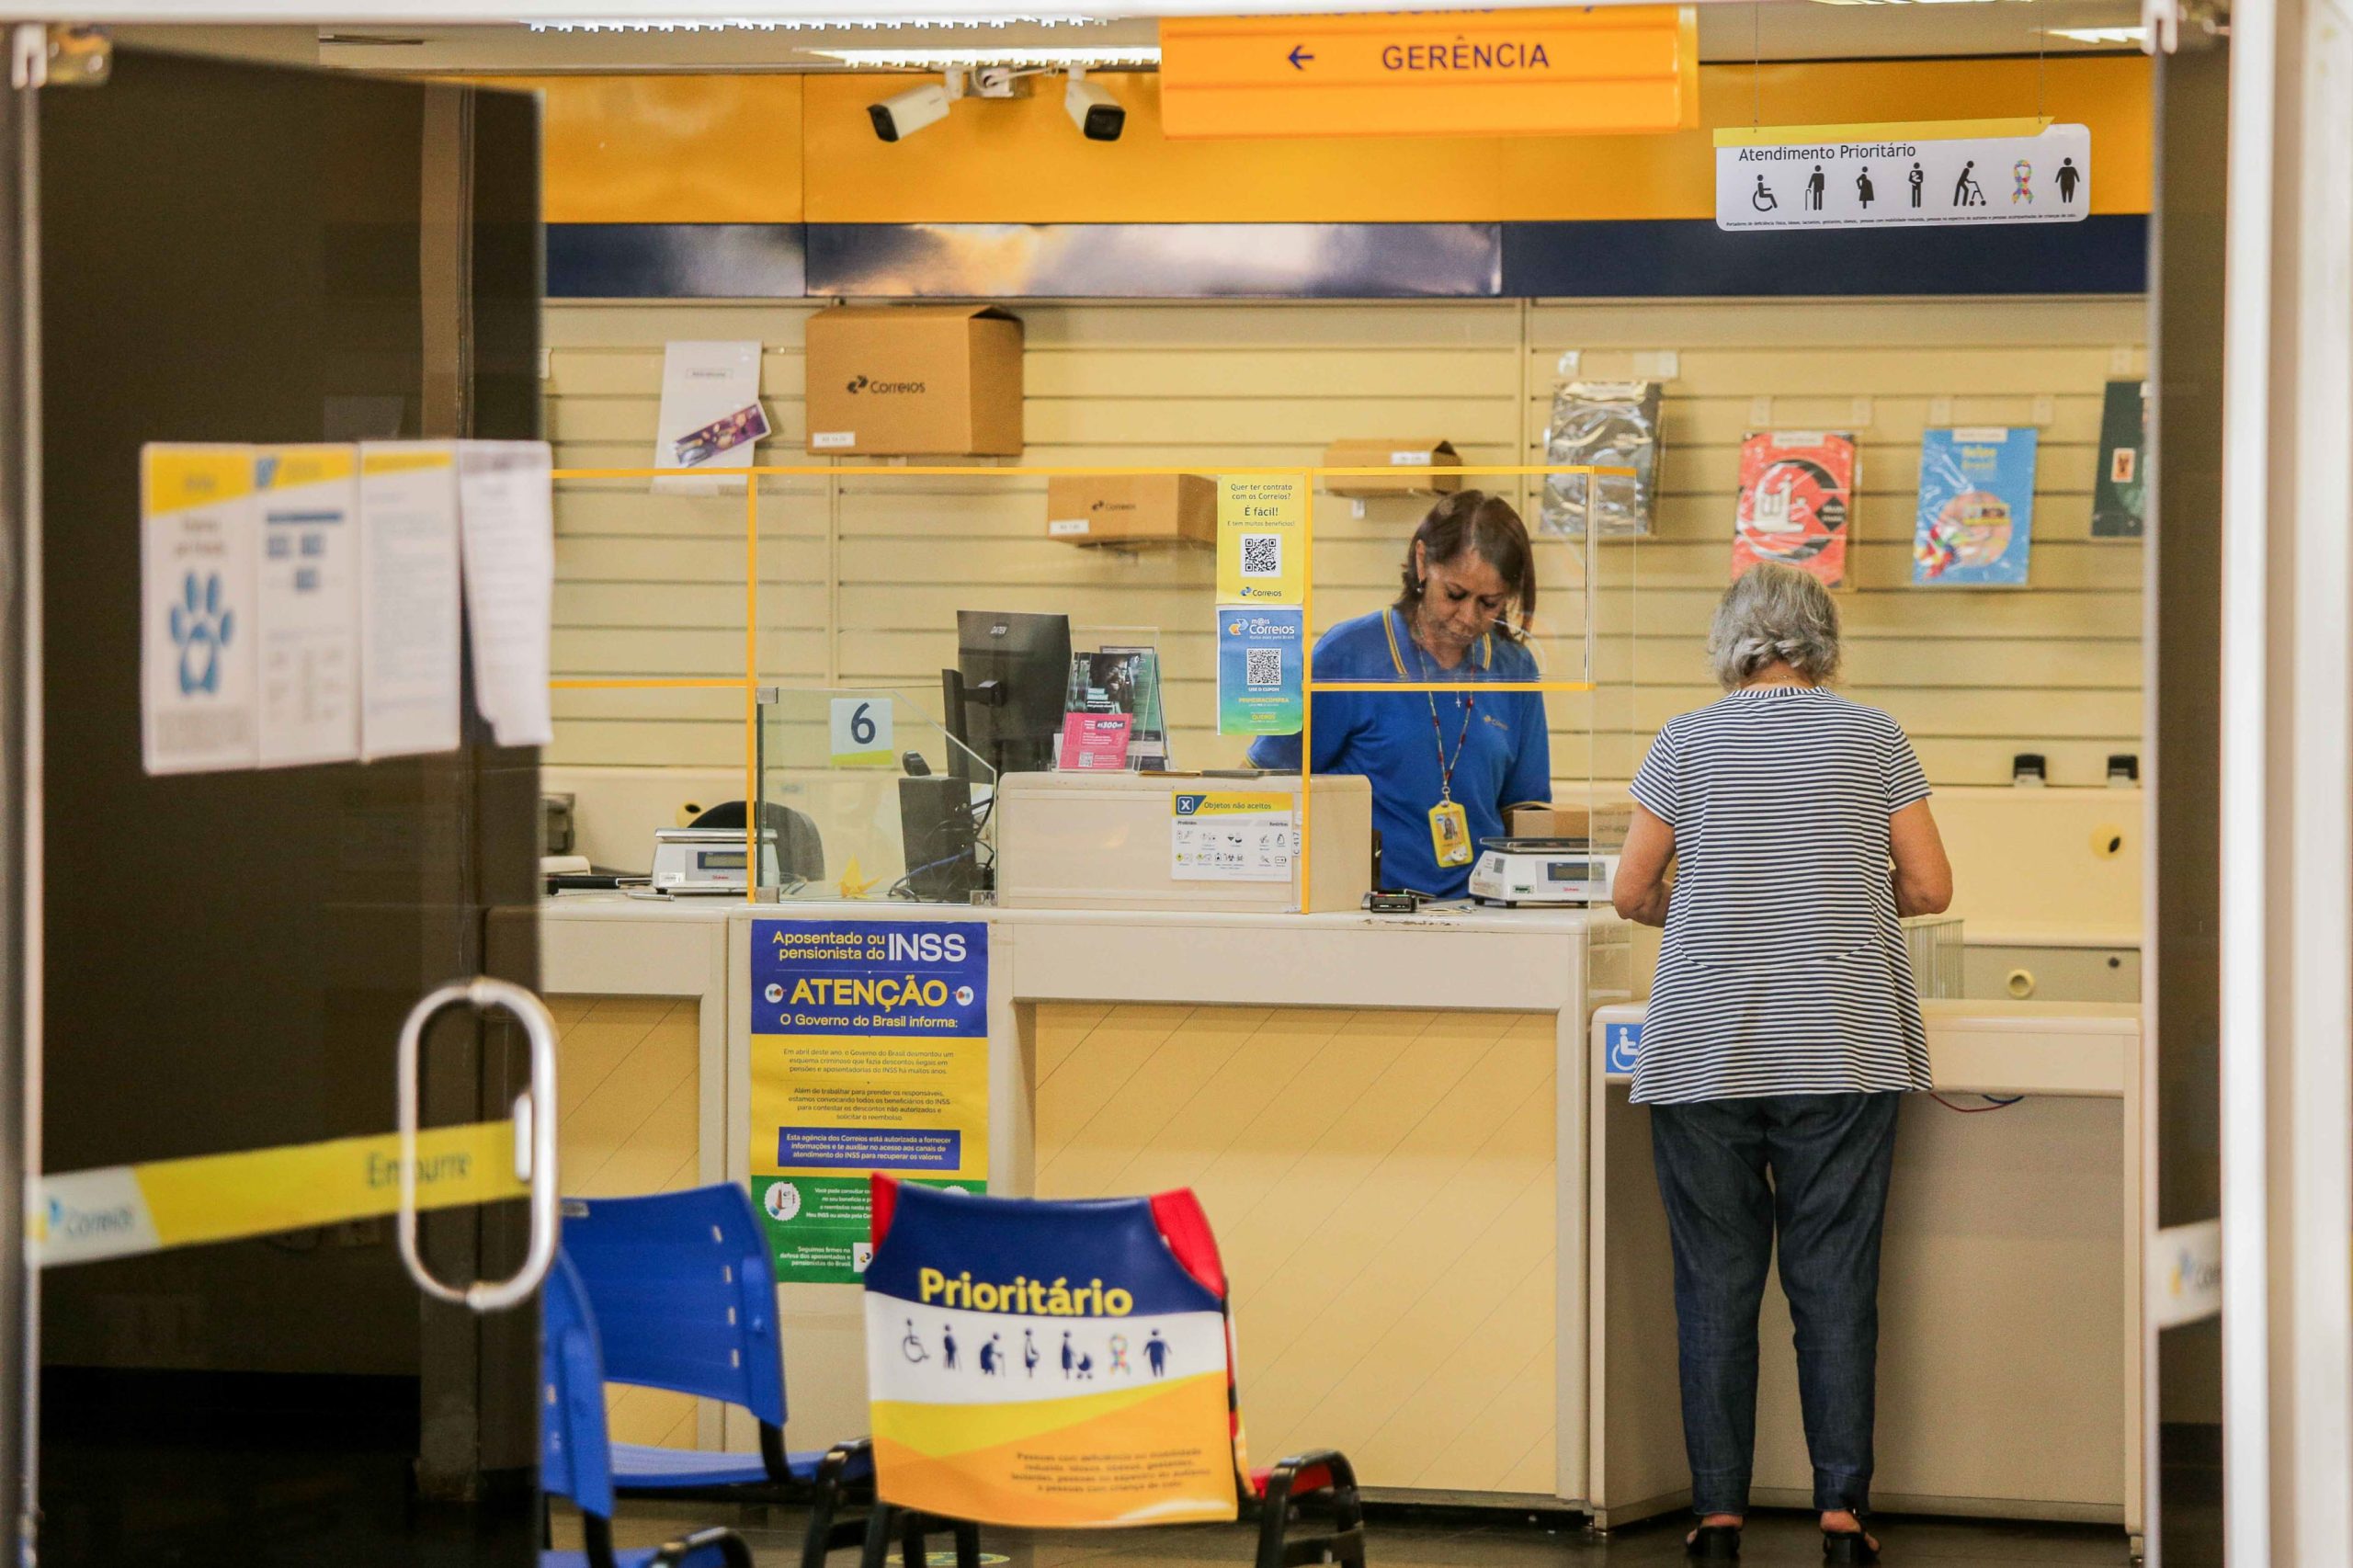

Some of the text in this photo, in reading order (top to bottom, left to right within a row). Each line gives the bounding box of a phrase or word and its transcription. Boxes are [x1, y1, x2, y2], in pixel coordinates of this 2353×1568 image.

[1382, 36, 1550, 71] GERÊNCIA
[1739, 143, 1916, 162] Atendimento Prioritário
[870, 381, 926, 394] Correios
[1245, 505, 1279, 517] É fácil!
[1251, 618, 1270, 626] m@is
[1249, 625, 1295, 634] Correios
[851, 702, 876, 744] 6
[1204, 801, 1231, 810] Objetos
[773, 930, 967, 962] Aposentado ou INSS
[779, 947, 885, 961] pensionista do
[790, 974, 949, 1012] ATENÇÃO
[779, 1014, 958, 1028] O Governo do Brasil informa:
[801, 1134, 827, 1142] agência
[919, 1267, 1133, 1317] Prioritário
